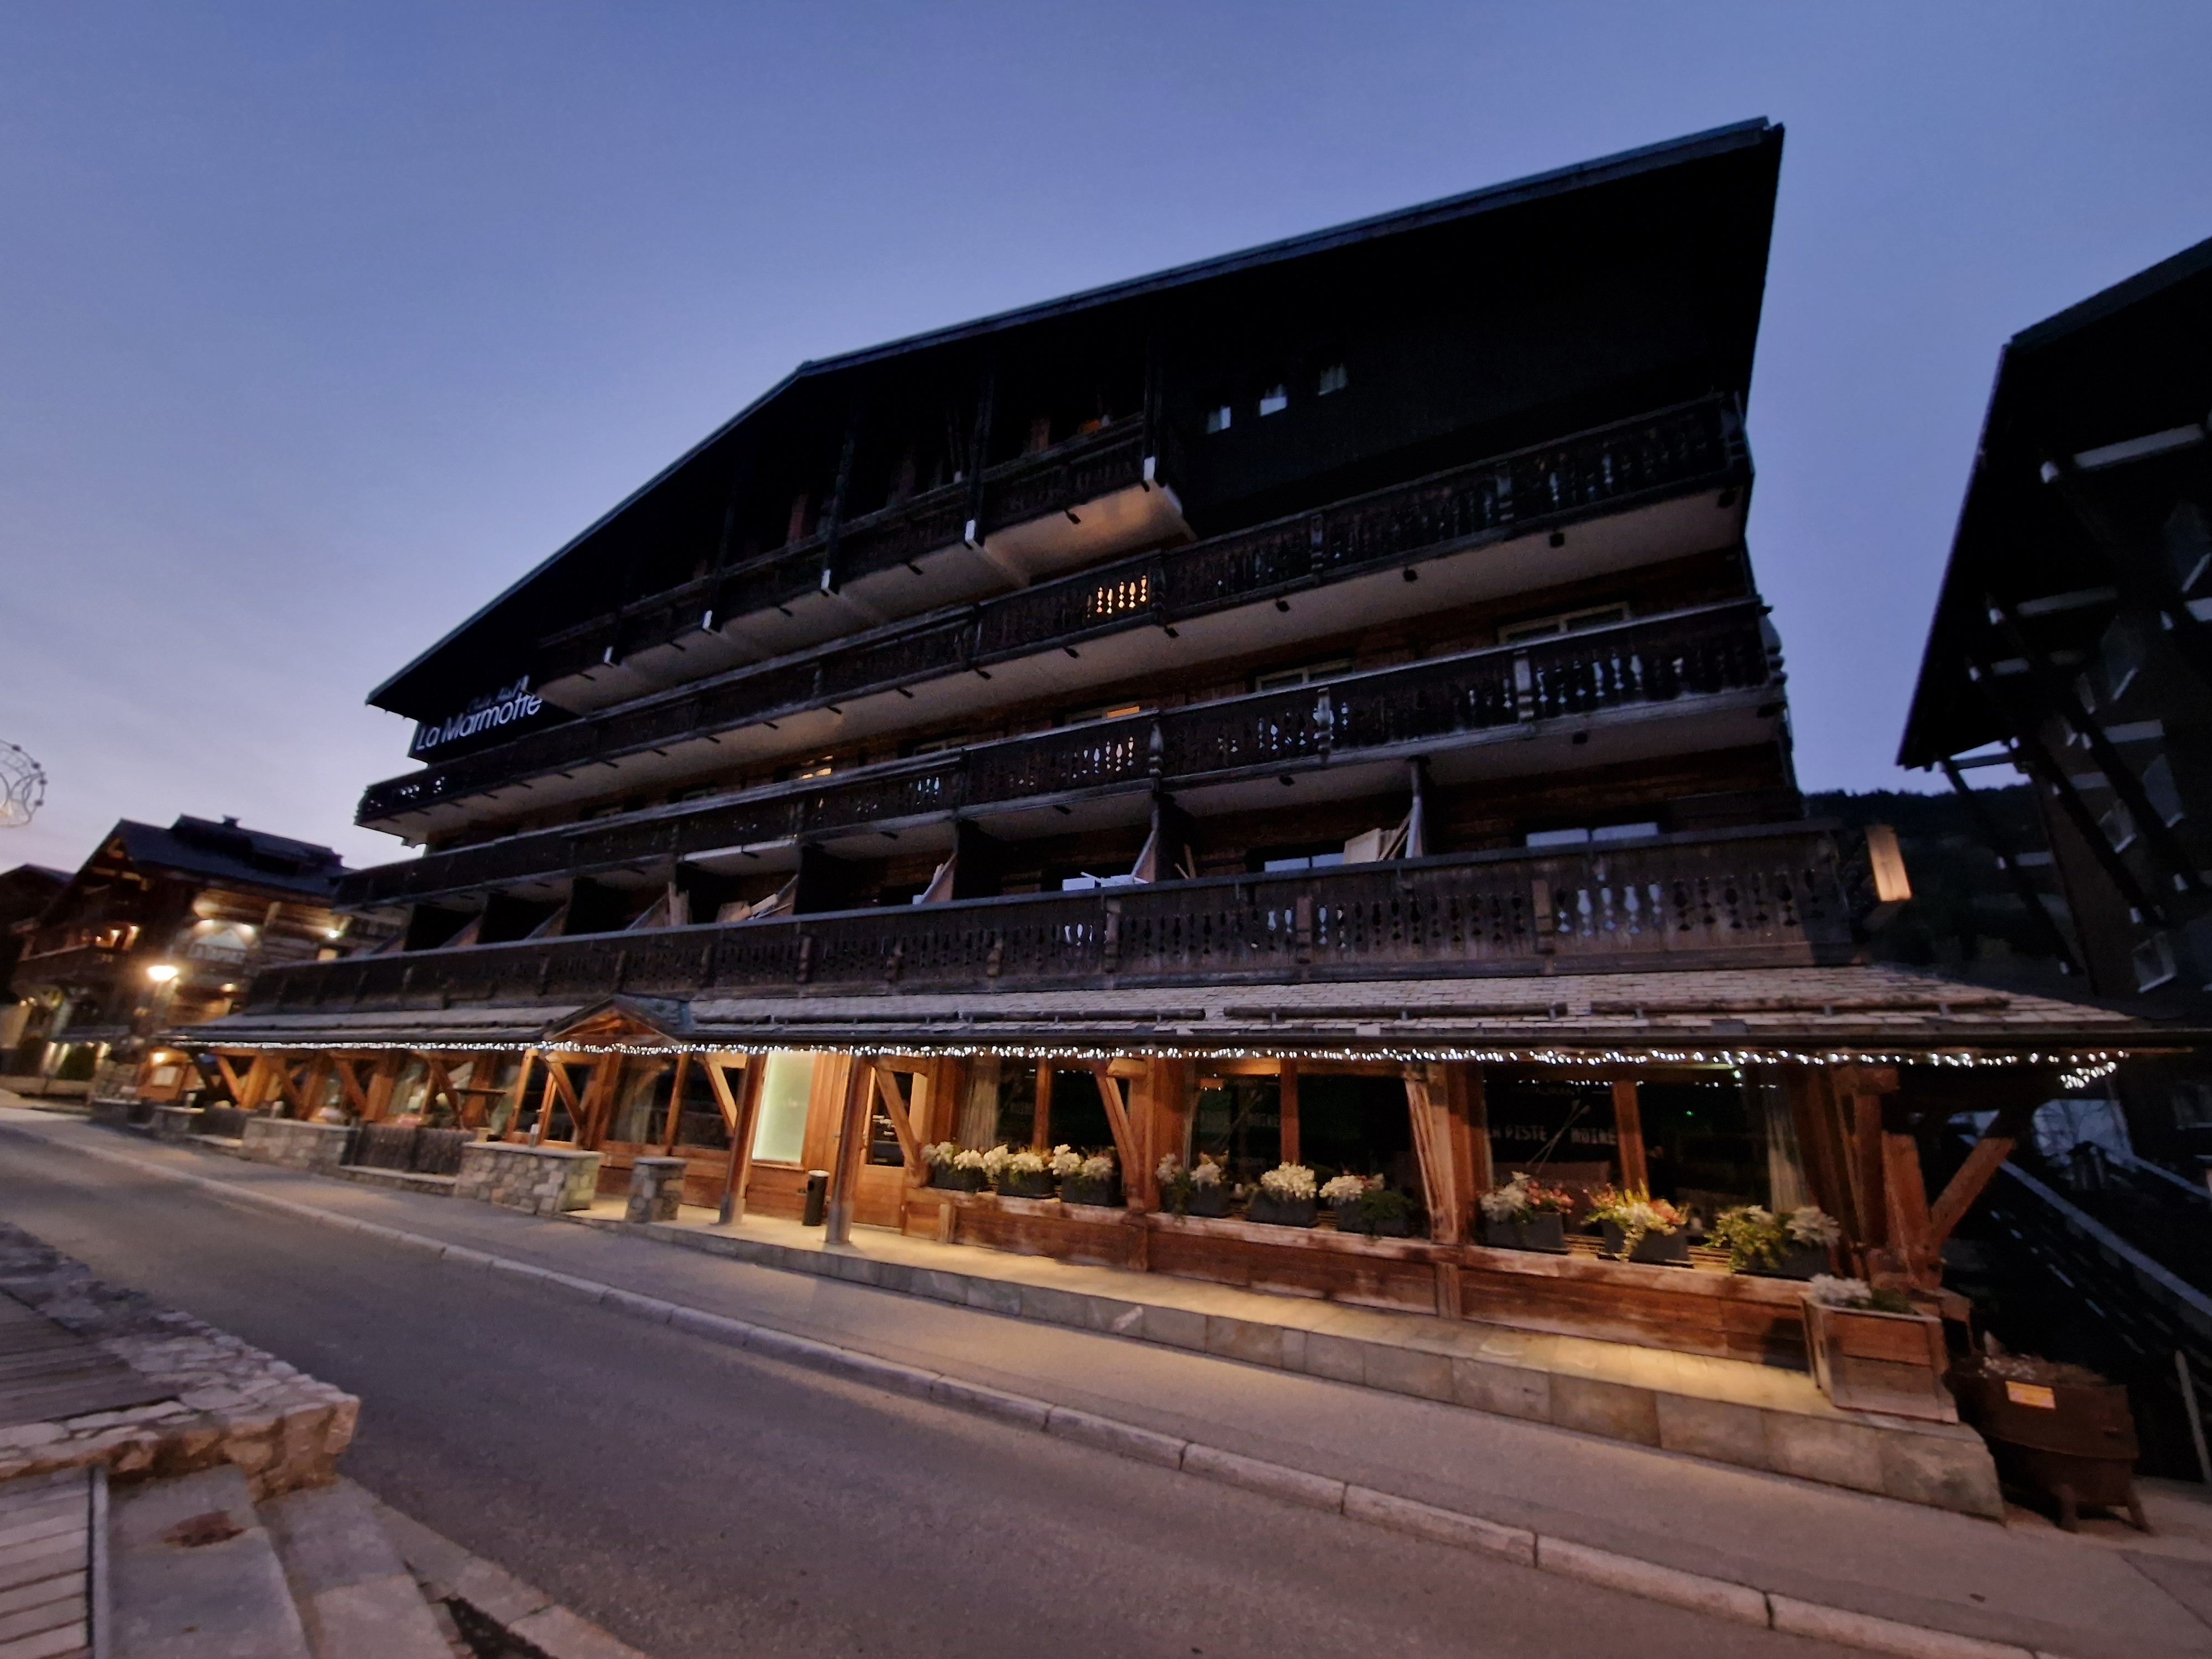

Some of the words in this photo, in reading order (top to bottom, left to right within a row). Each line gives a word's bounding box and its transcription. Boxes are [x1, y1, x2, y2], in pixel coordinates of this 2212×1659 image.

[415, 725, 441, 750] La
[441, 691, 542, 743] Marmotte
[1505, 1124, 1548, 1142] PISTE
